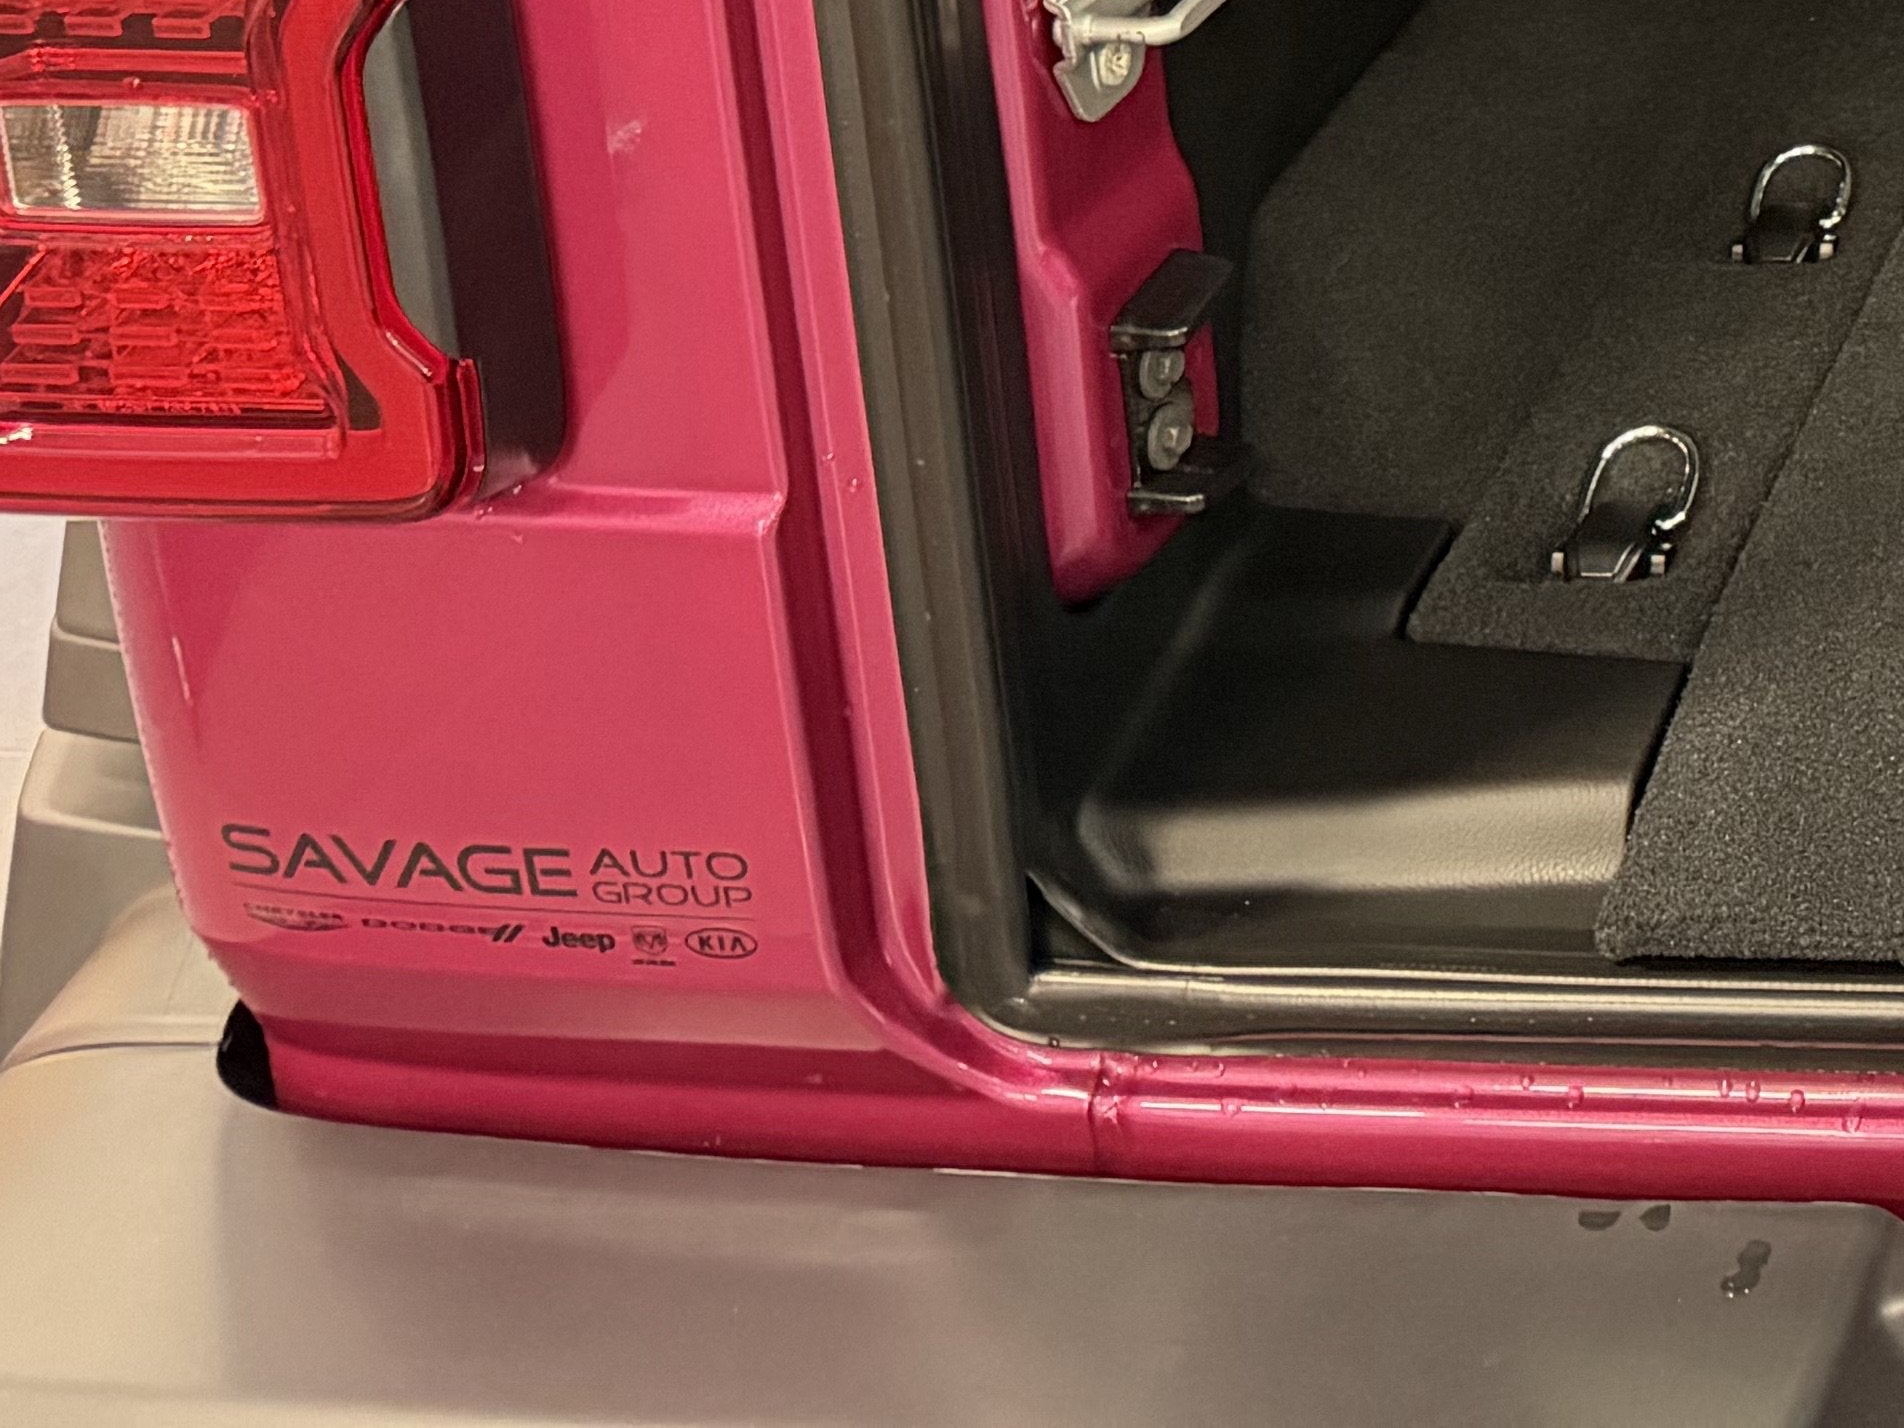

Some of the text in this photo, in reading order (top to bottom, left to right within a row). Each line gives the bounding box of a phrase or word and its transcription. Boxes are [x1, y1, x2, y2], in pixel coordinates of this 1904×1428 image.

[221, 822, 748, 898] SAVAGE AUTO
[592, 880, 753, 909] GROUP
[543, 925, 616, 954] Jeep
